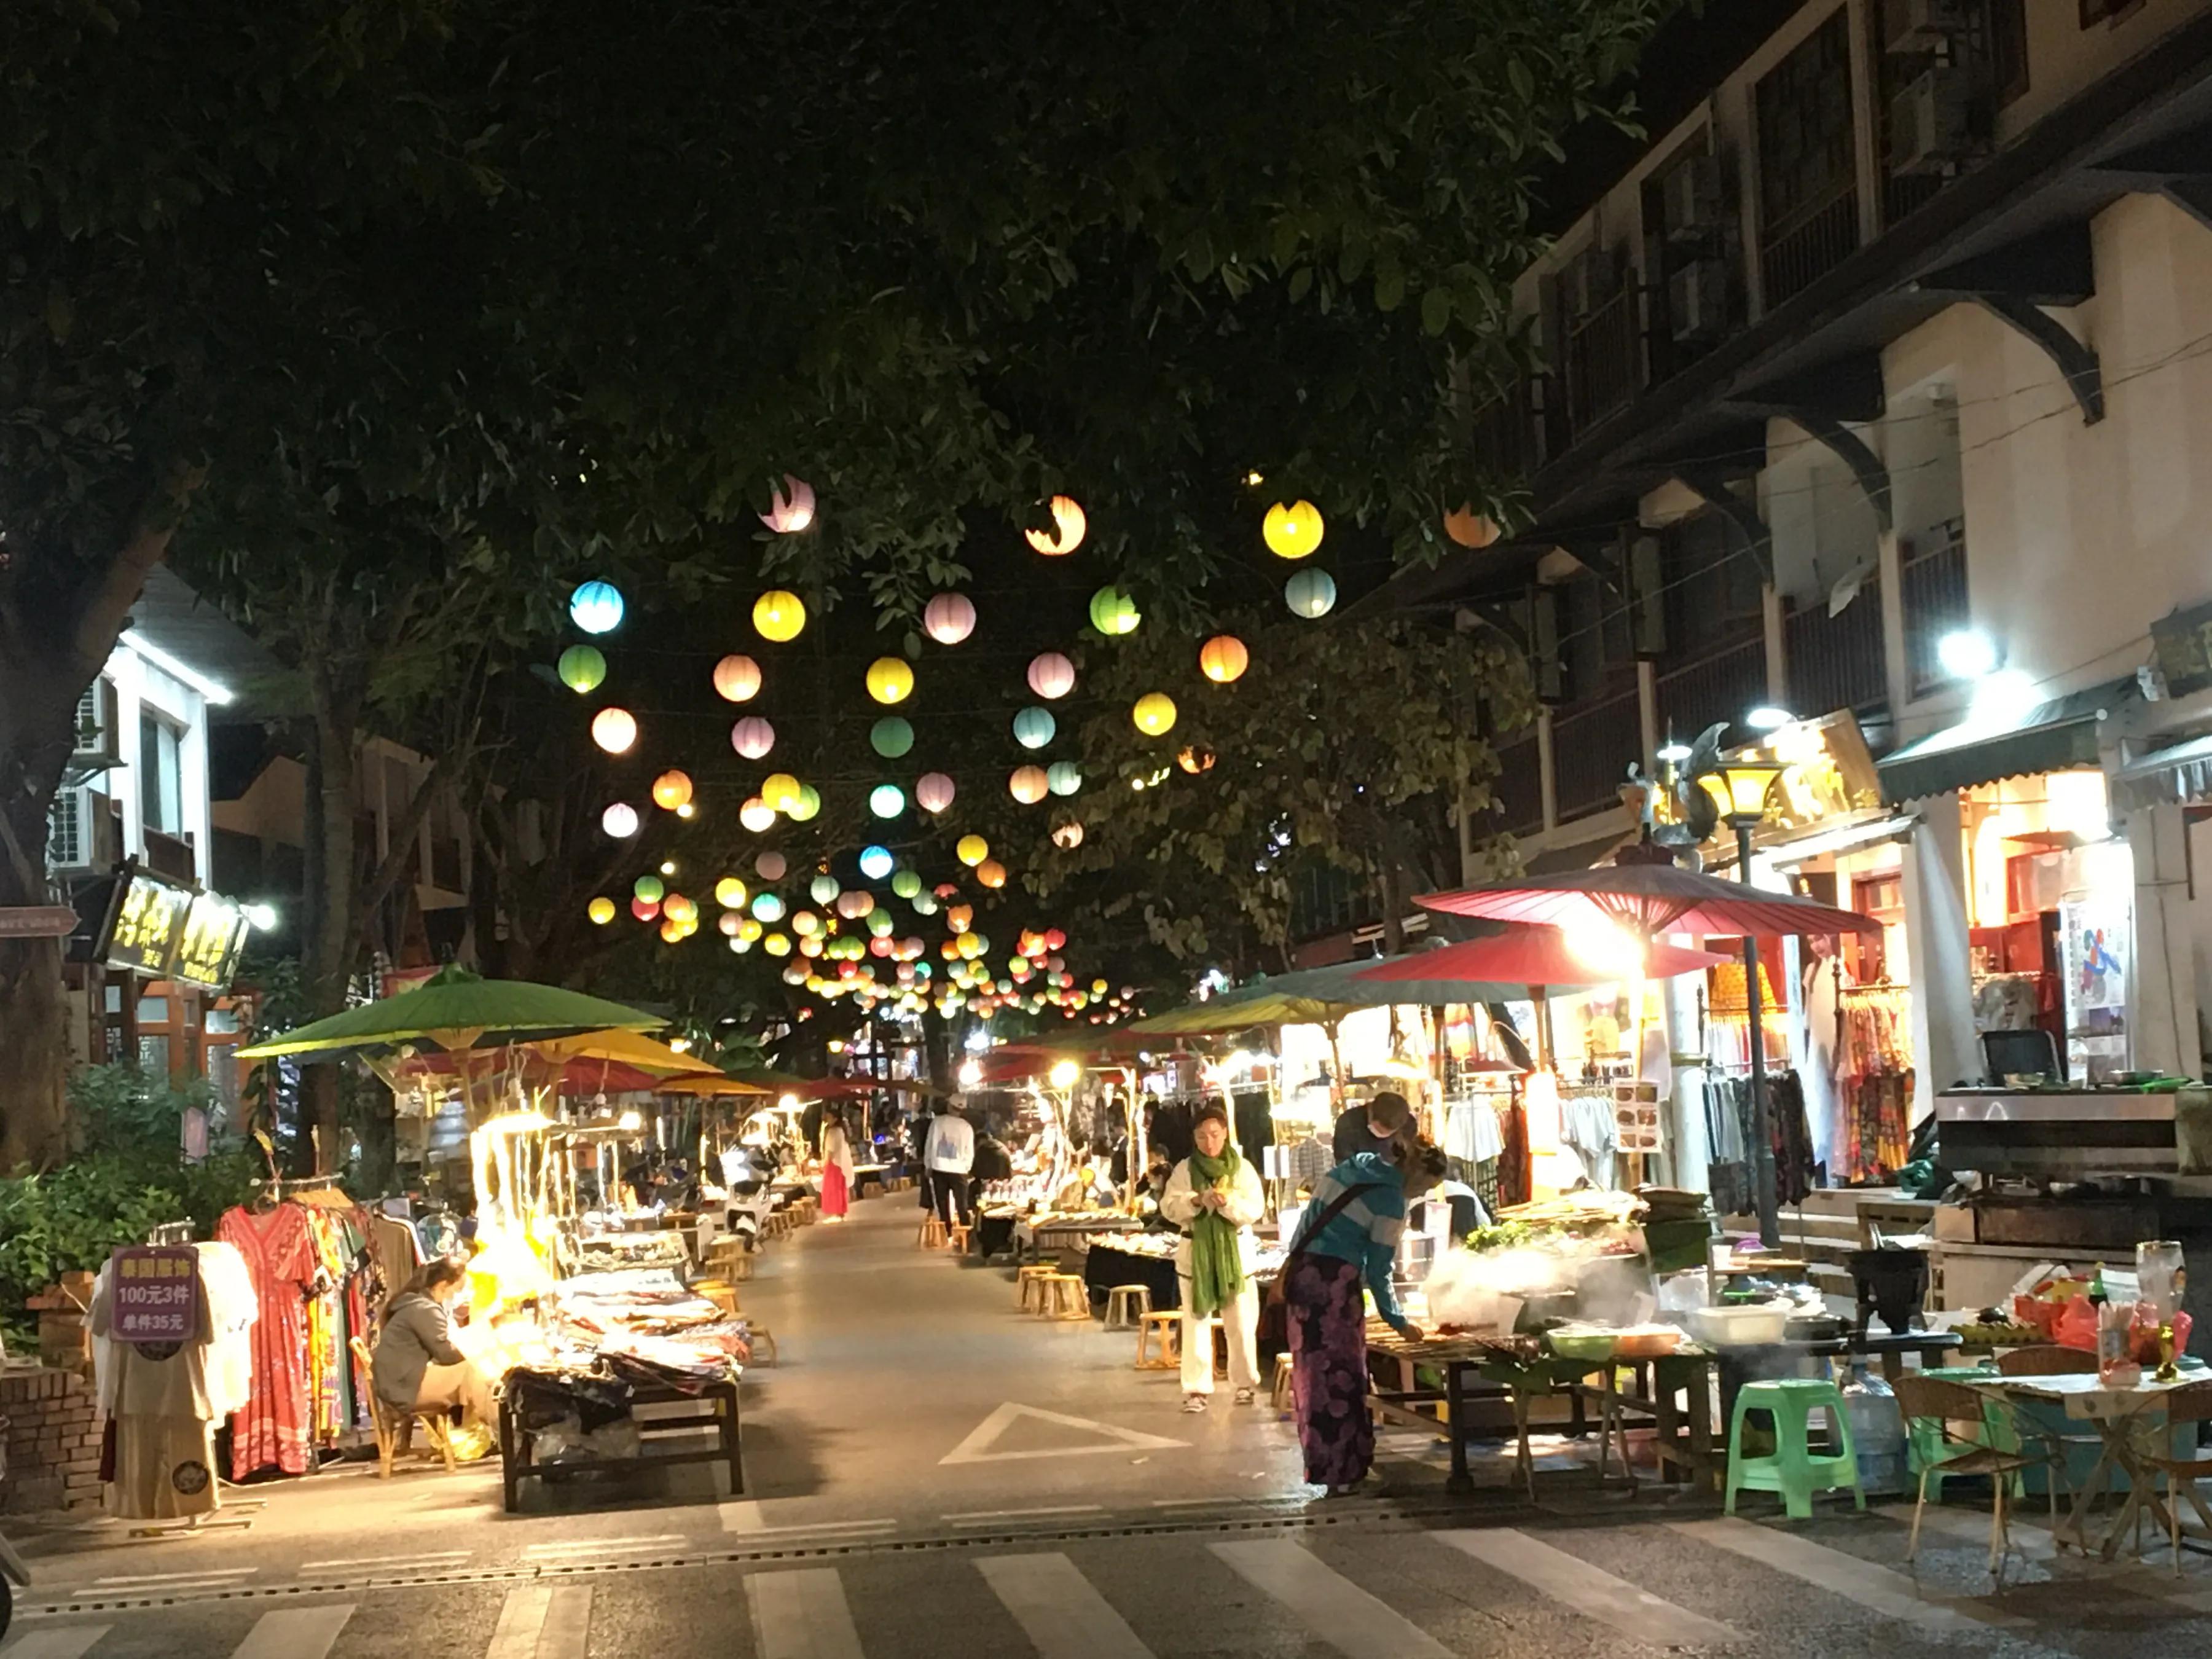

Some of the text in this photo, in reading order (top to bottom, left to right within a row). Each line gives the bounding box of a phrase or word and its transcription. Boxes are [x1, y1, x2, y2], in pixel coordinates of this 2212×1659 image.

[119, 1284, 189, 1304] 100元3件
[122, 1313, 184, 1331] 单件35元
